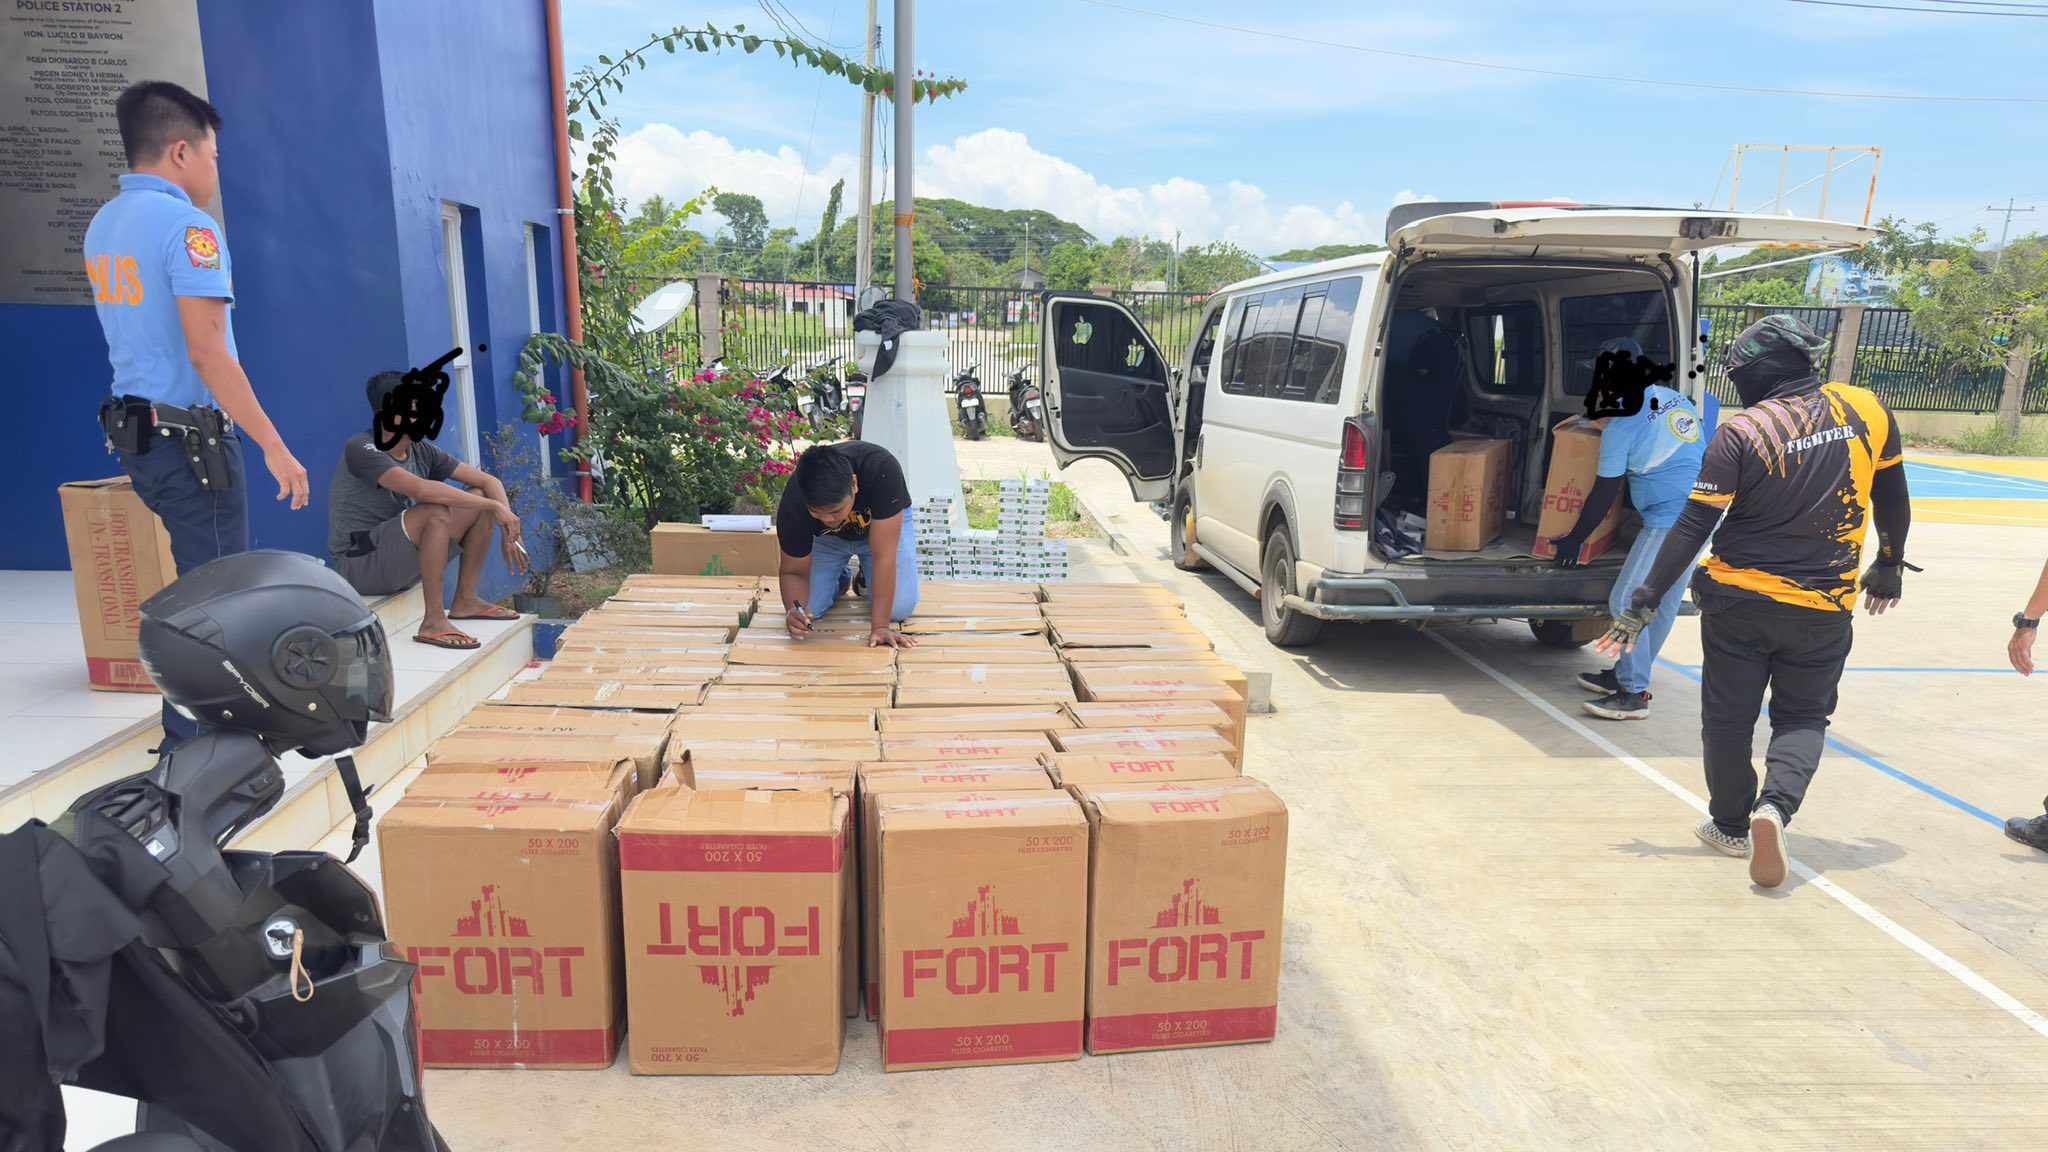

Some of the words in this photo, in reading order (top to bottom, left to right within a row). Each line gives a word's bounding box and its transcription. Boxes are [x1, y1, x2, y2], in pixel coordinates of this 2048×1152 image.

[16, 1, 59, 11] POLICE
[63, 2, 112, 13] STATION
[114, 4, 122, 13] 2
[1785, 424, 1858, 454] FIGHTER
[1543, 495, 1584, 513] FOR
[1109, 759, 1175, 773] FORT
[1151, 799, 1222, 814] FORT
[528, 838, 542, 848] 50
[559, 838, 579, 848] 200
[1025, 836, 1040, 847] 50
[1055, 836, 1073, 846] 200
[705, 851, 729, 862] 200
[734, 851, 743, 862] X
[746, 852, 763, 862] 50
[646, 902, 820, 956] FORT
[1107, 929, 1265, 986] FORT
[407, 946, 585, 998] FORT
[903, 942, 1069, 998] FORT
[1157, 1022, 1171, 1032] 50
[1175, 1021, 1182, 1031] X
[1186, 1020, 1208, 1030] 200
[472, 1039, 489, 1049] 50
[494, 1039, 501, 1049] X
[506, 1039, 530, 1049] 200
[956, 1036, 973, 1046] 50
[975, 1035, 983, 1046] X
[986, 1034, 1009, 1045] 200
[651, 1053, 672, 1062] 200
[686, 1054, 700, 1062] 50
